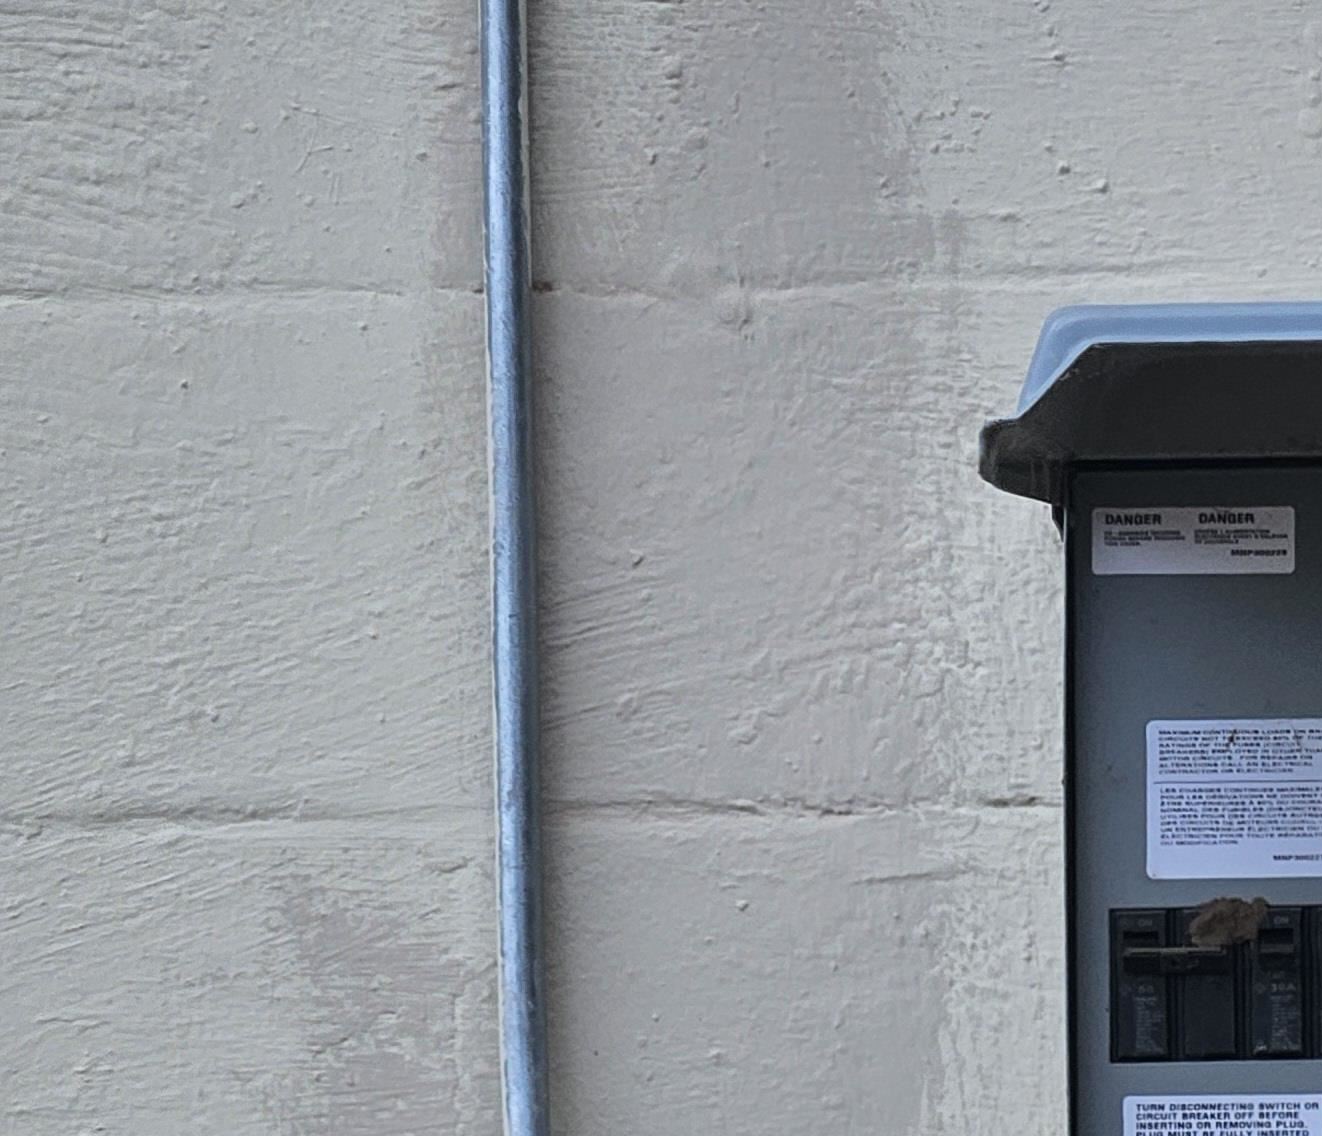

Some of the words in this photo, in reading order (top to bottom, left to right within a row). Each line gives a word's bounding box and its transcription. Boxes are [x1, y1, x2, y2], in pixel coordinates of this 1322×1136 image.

[1104, 514, 1162, 525] DANGER
[1198, 513, 1255, 524] DANGER
[1136, 1103, 1165, 1111] TURN
[1169, 1102, 1255, 1111] DISCONNECTING
[1258, 1102, 1301, 1110] SWITCH
[1304, 1102, 1319, 1110] OR
[1136, 1112, 1177, 1121] CIRCUIT
[1182, 1112, 1231, 1120] BREAKER
[1234, 1111, 1254, 1120] OFF
[1258, 1111, 1299, 1119] BEFORE
[1136, 1121, 1193, 1130] INSERTING
[1196, 1121, 1211, 1129] OR
[1215, 1121, 1271, 1129] REMOVING
